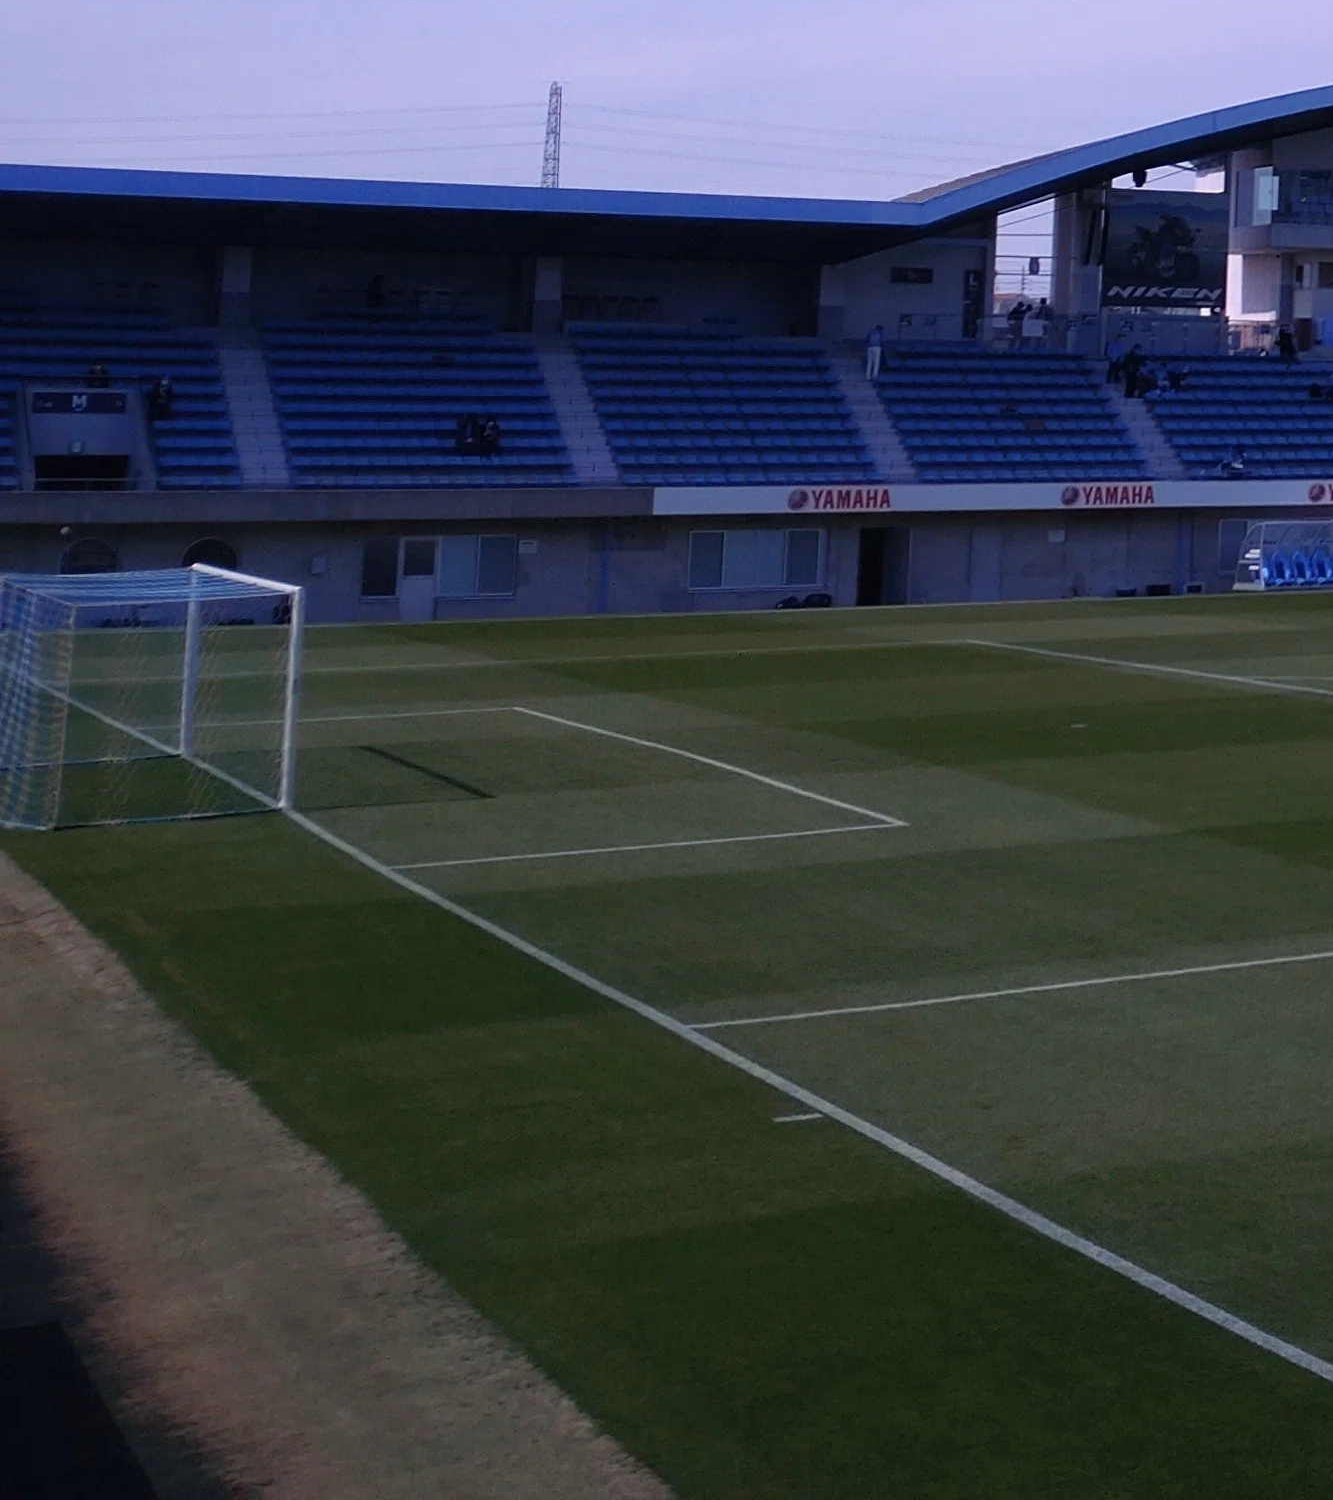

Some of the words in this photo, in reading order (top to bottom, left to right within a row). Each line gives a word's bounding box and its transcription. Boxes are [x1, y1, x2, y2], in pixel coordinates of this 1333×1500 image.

[1106, 285, 1223, 301] NIKEN
[811, 488, 891, 510] YAMAHA
[1082, 485, 1155, 505] YAMAHA
